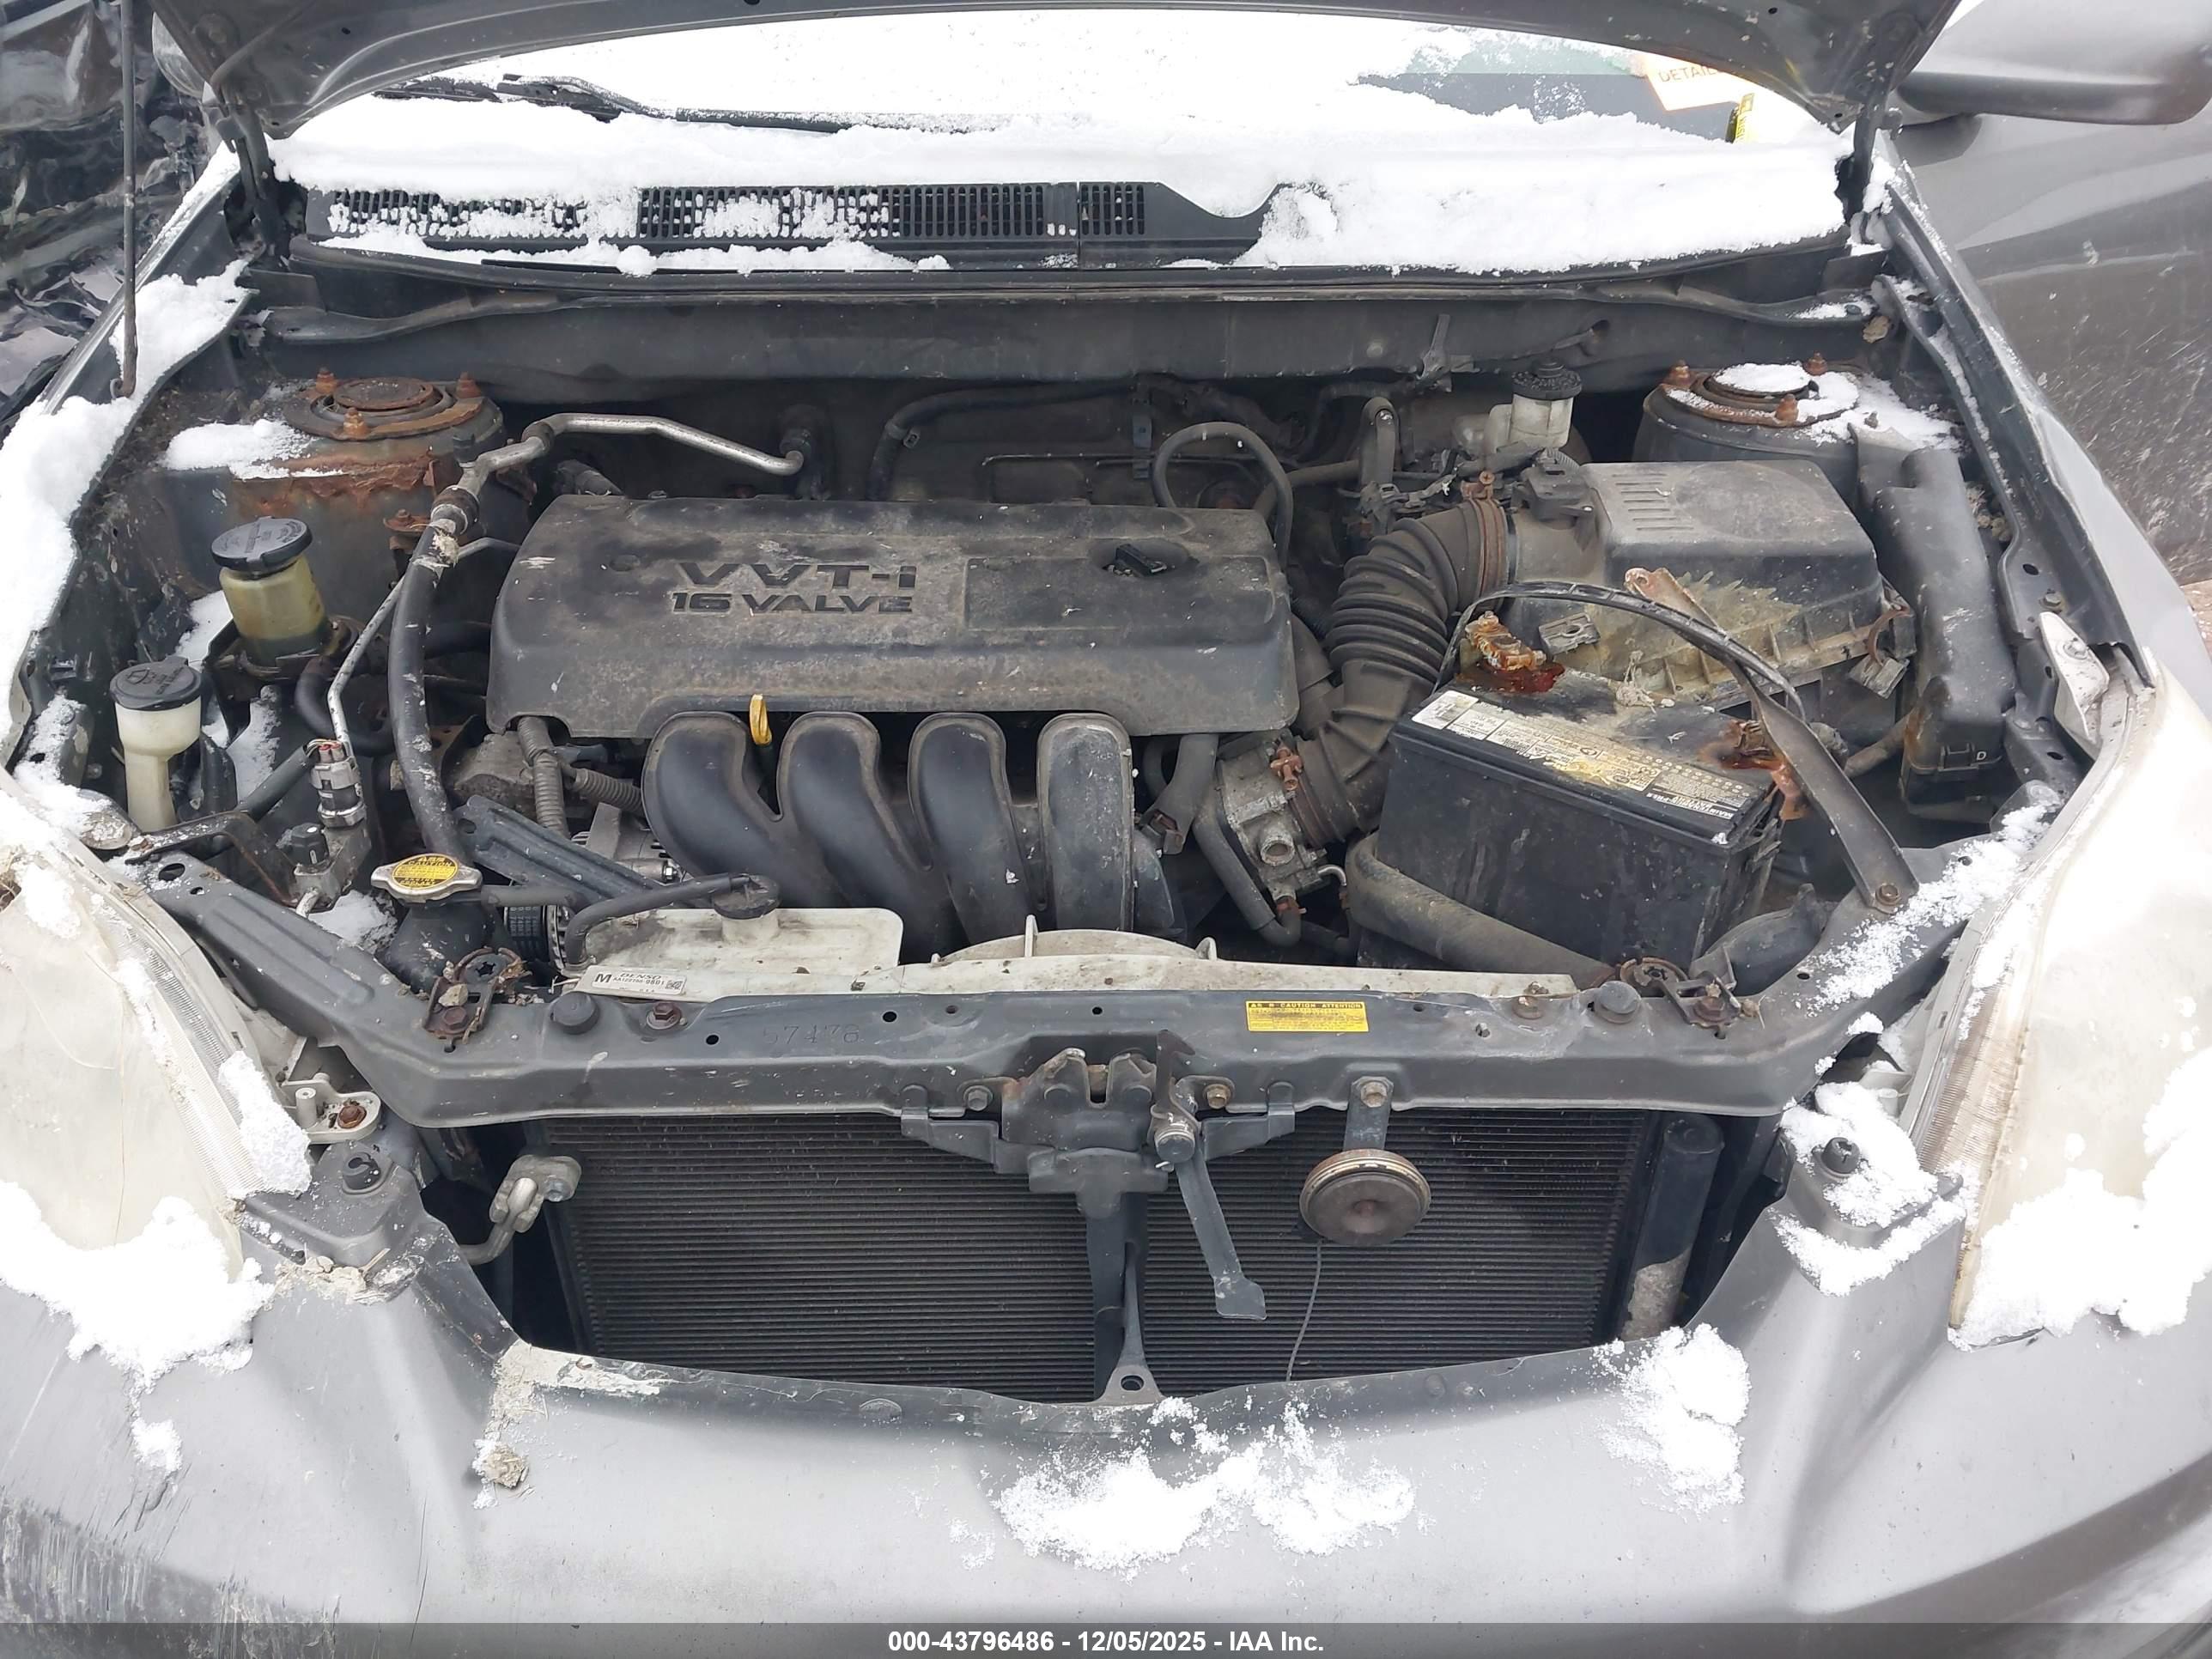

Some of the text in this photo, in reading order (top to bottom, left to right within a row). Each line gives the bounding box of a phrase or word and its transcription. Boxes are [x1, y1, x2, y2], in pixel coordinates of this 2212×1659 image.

[672, 592, 913, 613] 16 VALVE
[594, 973, 611, 983] M
